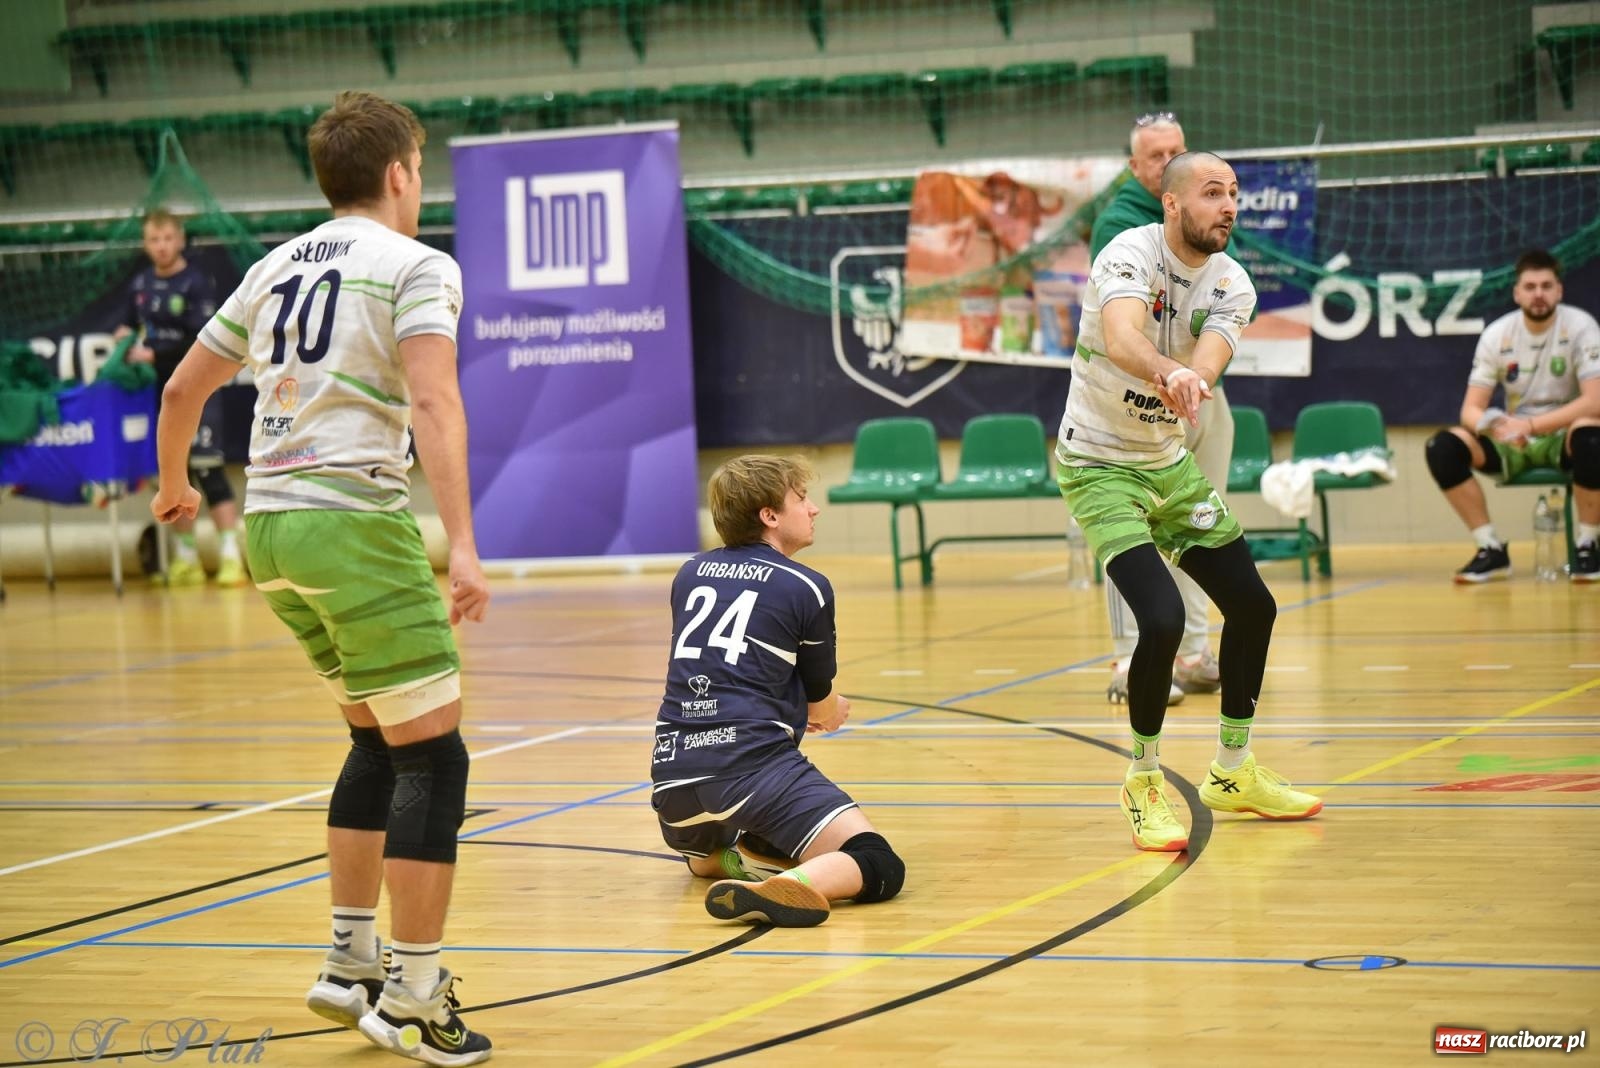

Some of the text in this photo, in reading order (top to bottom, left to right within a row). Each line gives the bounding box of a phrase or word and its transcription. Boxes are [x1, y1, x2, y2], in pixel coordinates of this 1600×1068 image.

[506, 169, 630, 291] bmp
[291, 239, 357, 263] SŁOWIK
[270, 268, 342, 365] 10
[474, 305, 666, 342] budujemy możliwości
[508, 336, 634, 371] porozumienia
[696, 561, 774, 583] URBAŃSKI
[674, 585, 759, 666] 24
[681, 699, 718, 711] MK SPORT
[681, 708, 719, 719] FOUNDATION
[683, 734, 737, 751] ZAWIERCIE
[684, 726, 737, 742] KULTURALNE
